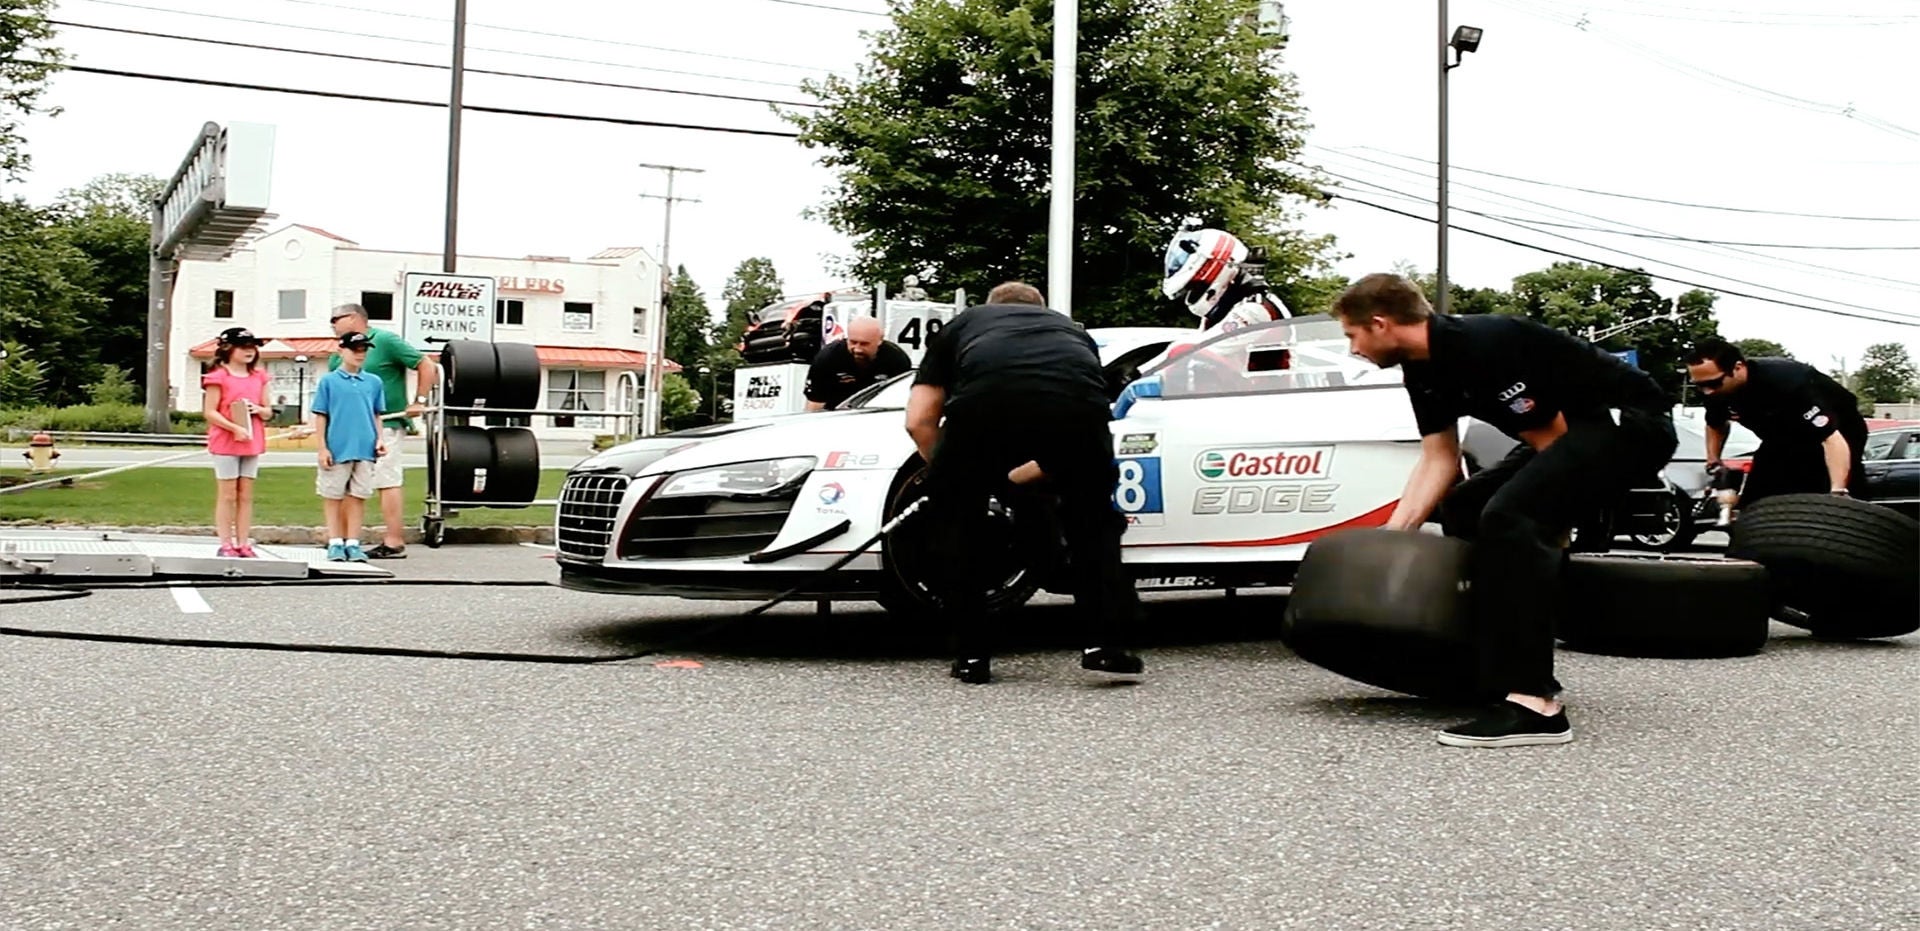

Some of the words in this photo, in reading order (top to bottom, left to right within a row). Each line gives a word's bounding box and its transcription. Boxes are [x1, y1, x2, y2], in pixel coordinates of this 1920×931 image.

[419, 281, 465, 292] PAUL
[497, 276, 565, 294] ELERS
[416, 289, 481, 300] MILLER
[412, 302, 486, 317] CUSTOMER
[420, 319, 477, 333] PARKING
[746, 385, 782, 398] MILLER
[1228, 451, 1323, 477] Castrol
[1115, 460, 1147, 512] 8
[1192, 484, 1340, 515] EDGE
[816, 507, 848, 516] TOTAL
[1134, 576, 1198, 588] MILLER
